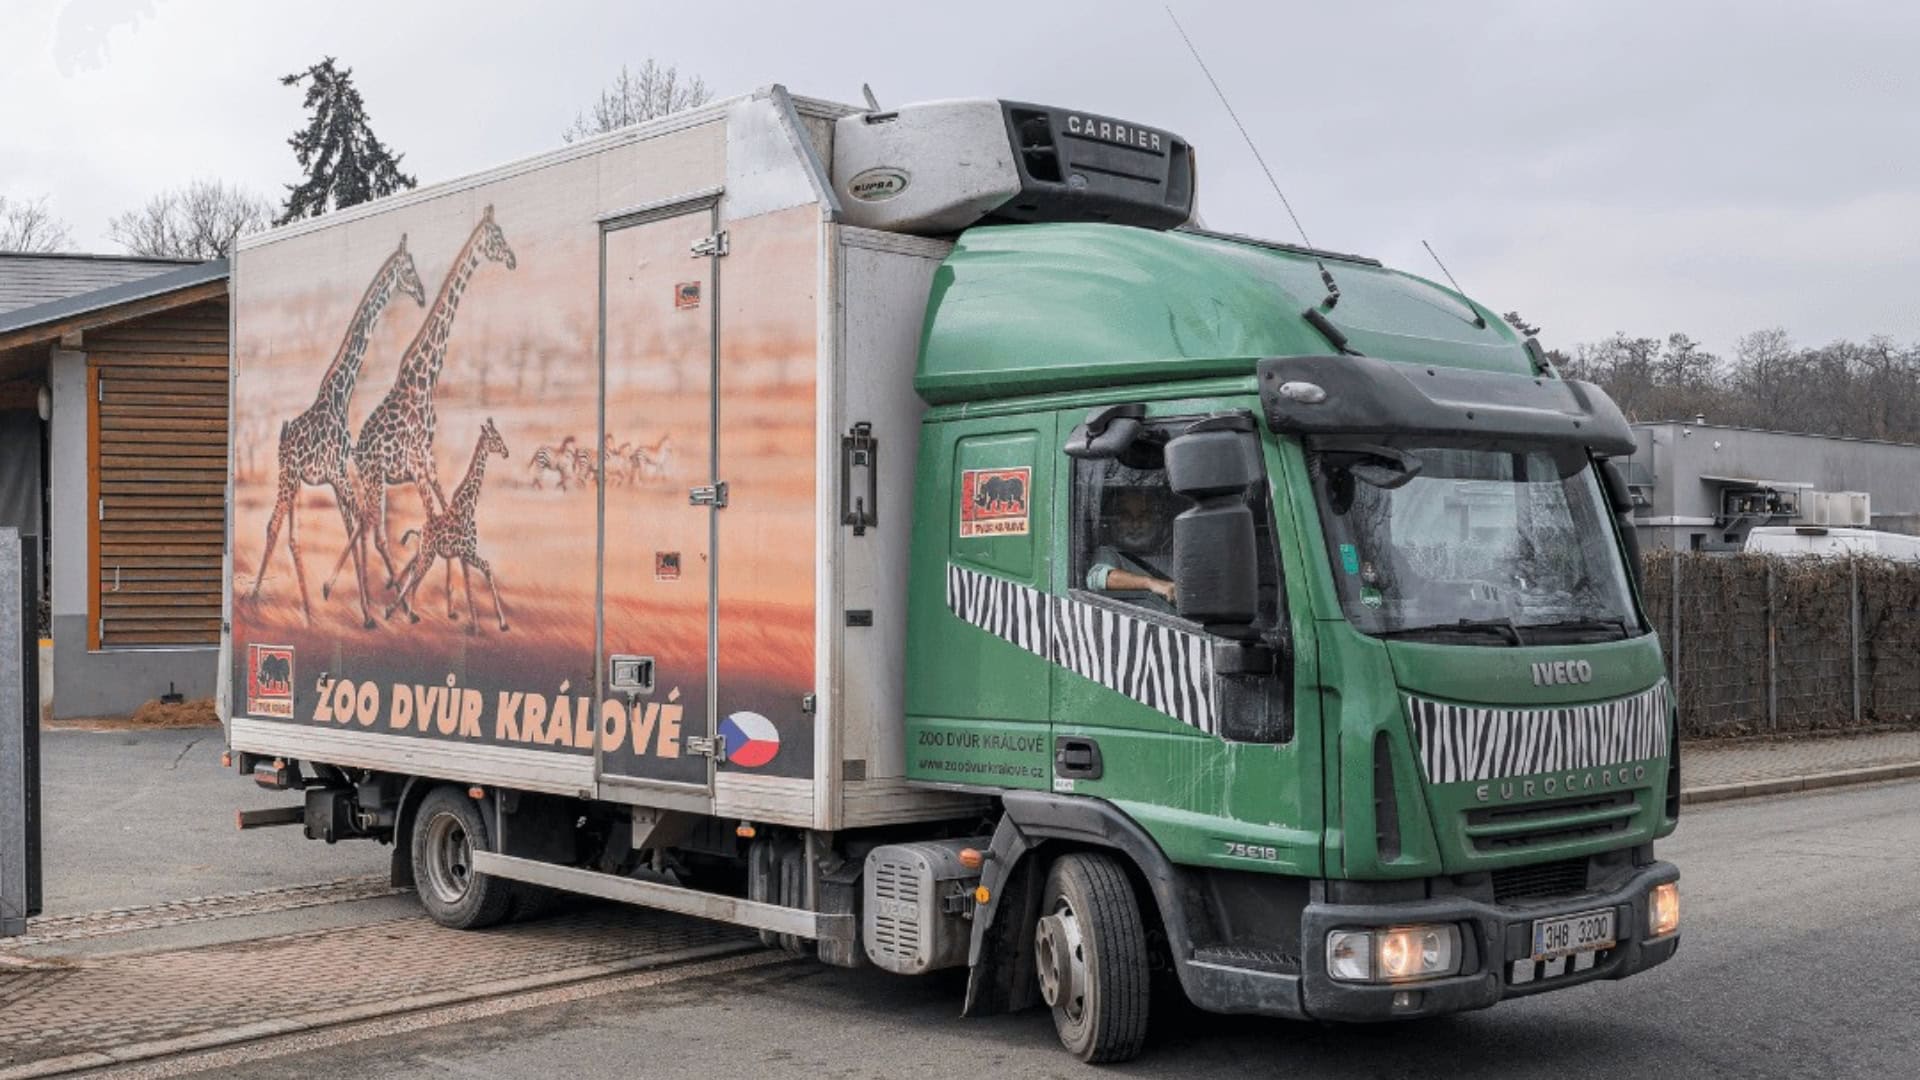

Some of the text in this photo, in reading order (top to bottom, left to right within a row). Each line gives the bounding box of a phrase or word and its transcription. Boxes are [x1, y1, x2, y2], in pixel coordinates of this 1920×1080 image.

[1067, 115, 1161, 151] CARRIER
[1531, 659, 1592, 687] IVECO
[312, 672, 684, 759] ZOO DVŮR KRÁLOVÉ
[918, 730, 944, 747] ZOO
[1476, 764, 1646, 802] EUROCARGO
[1545, 916, 1608, 950] 3H8 3200
